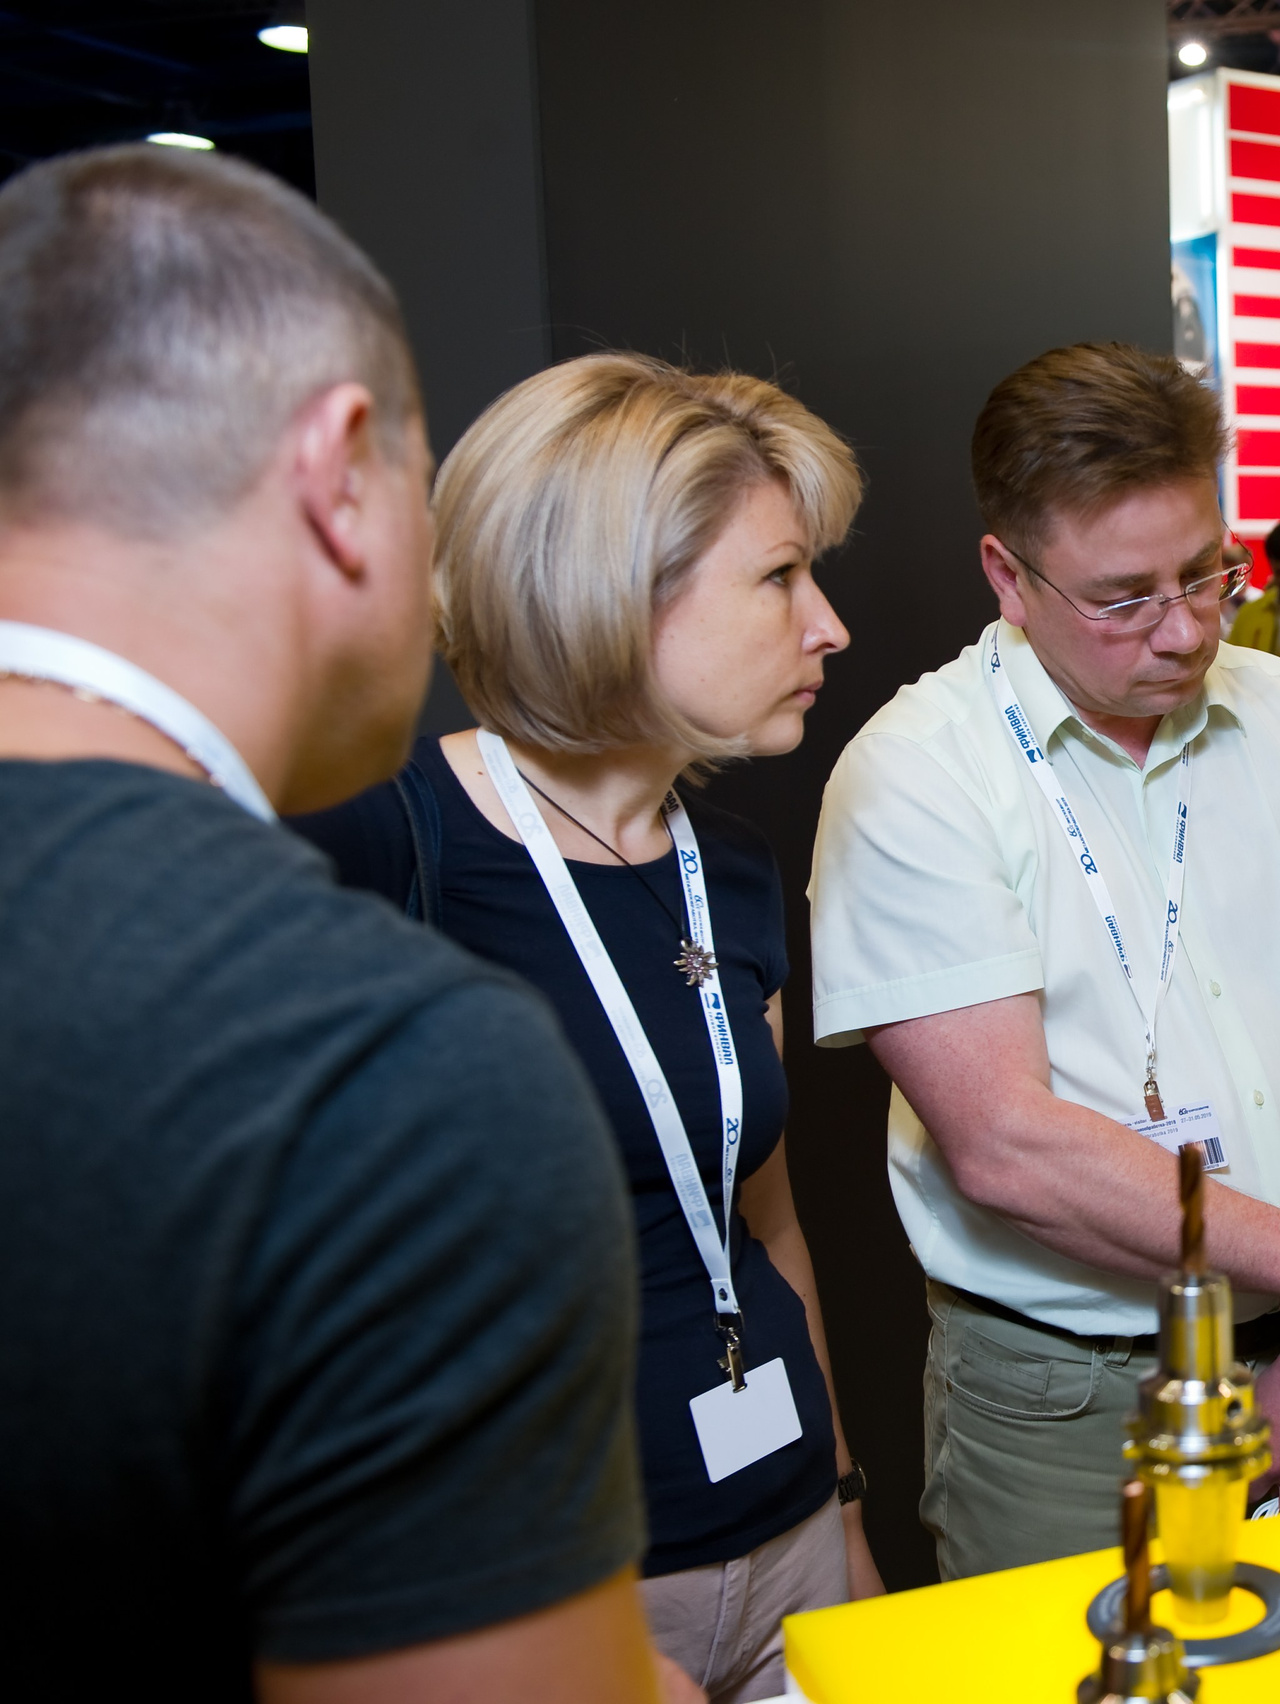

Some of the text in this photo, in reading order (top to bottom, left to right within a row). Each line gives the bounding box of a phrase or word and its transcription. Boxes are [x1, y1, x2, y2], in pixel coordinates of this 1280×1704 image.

[1004, 705, 1030, 749] ФИНВАЛ
[1176, 820, 1187, 864] ФИНВАЛ
[680, 850, 698, 874] 20
[1080, 853, 1098, 875] 20
[1167, 899, 1178, 924] 20
[1105, 915, 1126, 962] ФИНВАЛ
[716, 1011, 734, 1066] ФИНВАЛ
[726, 1118, 739, 1145] 20
